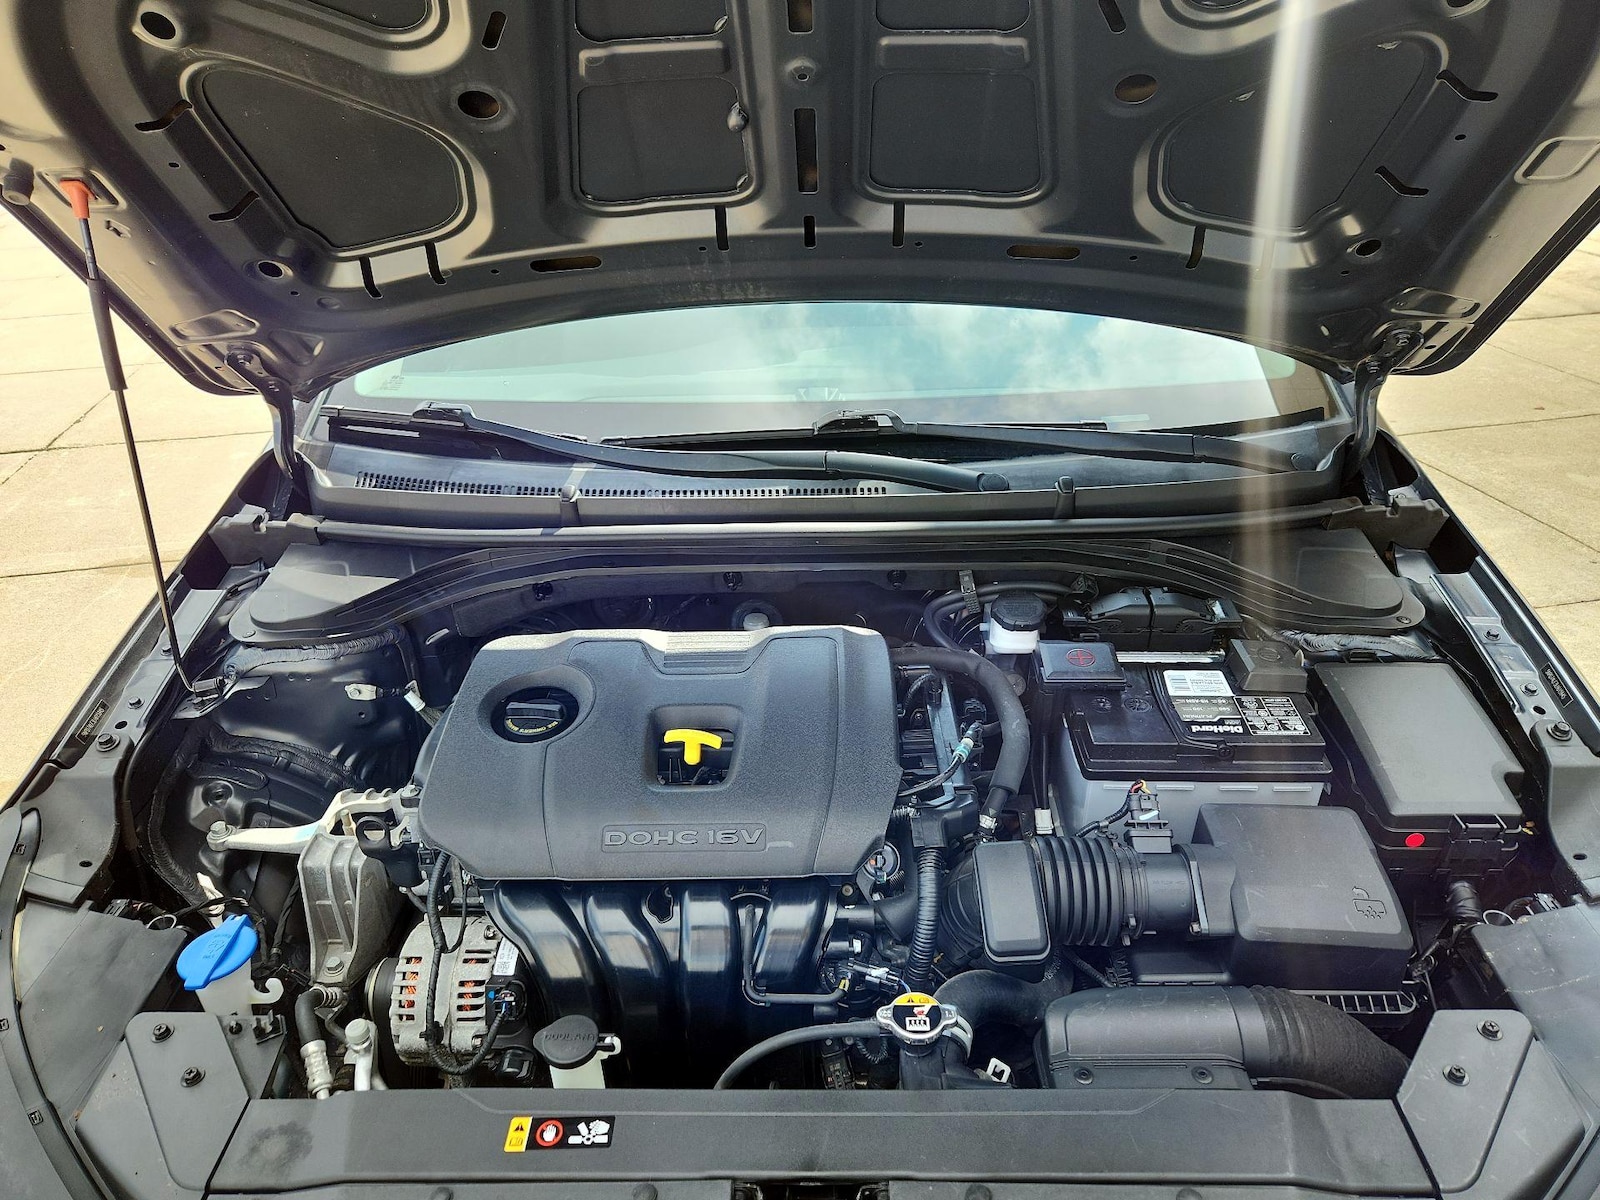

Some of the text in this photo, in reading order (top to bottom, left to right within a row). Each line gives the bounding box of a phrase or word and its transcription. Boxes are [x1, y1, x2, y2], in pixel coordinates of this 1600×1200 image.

[1191, 725, 1244, 733] DieHard
[604, 828, 764, 846] DOHC 16V
